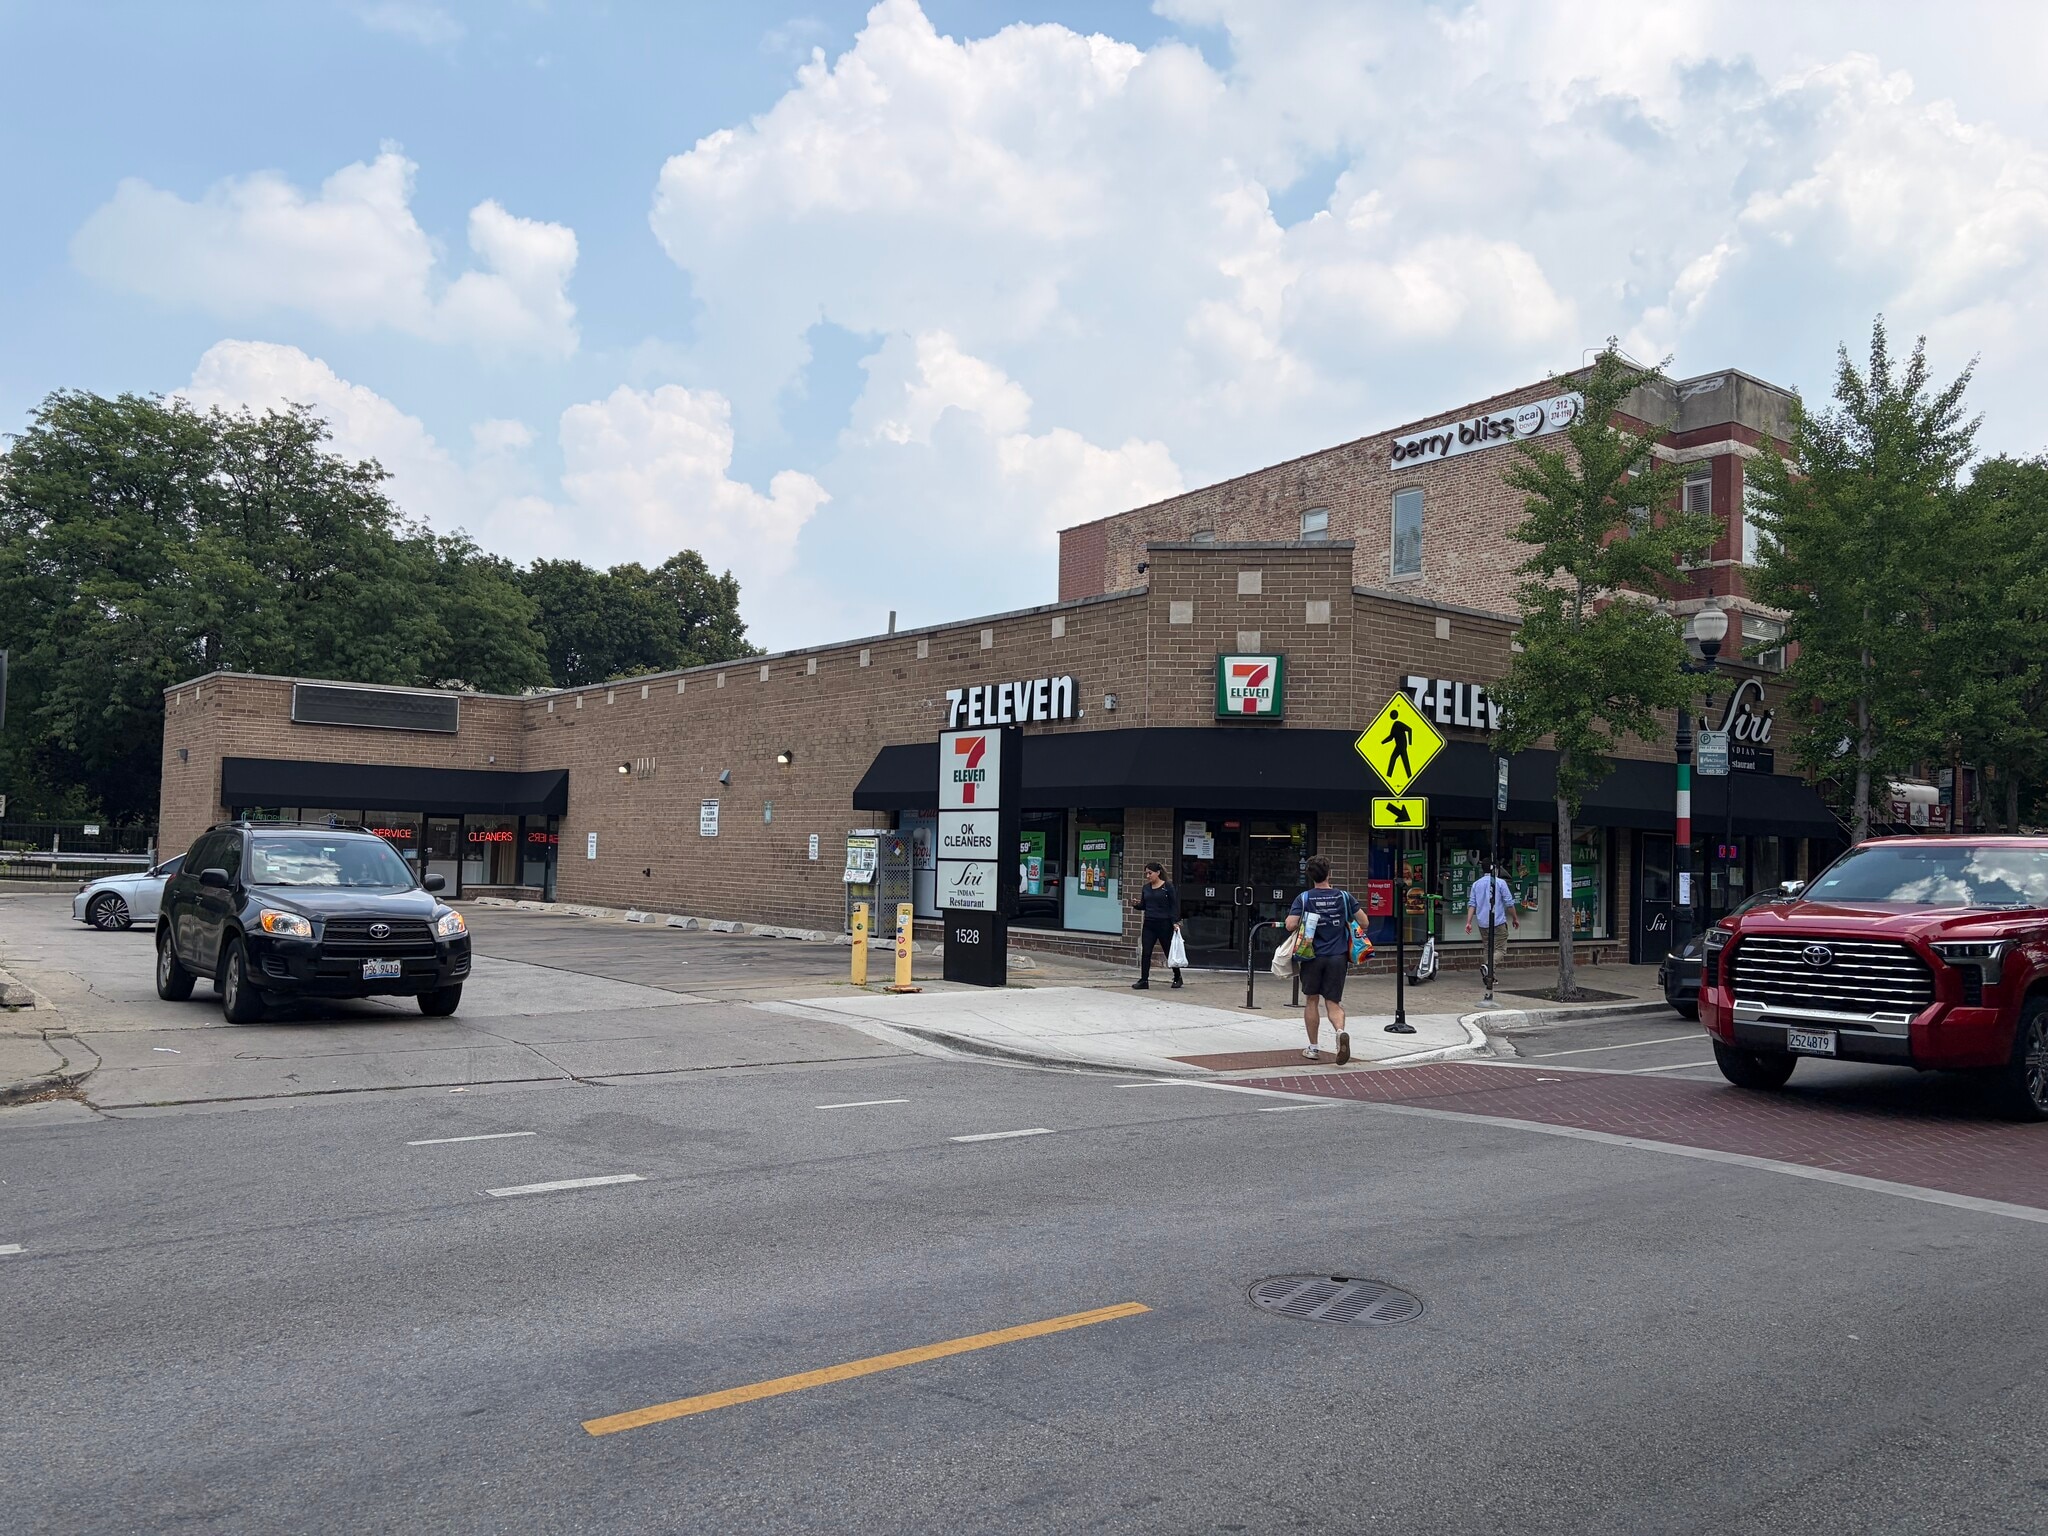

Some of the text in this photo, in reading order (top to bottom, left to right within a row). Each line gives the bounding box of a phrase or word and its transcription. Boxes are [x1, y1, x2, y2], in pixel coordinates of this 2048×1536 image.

[1556, 400, 1568, 410] 312
[1518, 409, 1539, 422] acai
[1391, 416, 1515, 462] berry bliss
[372, 828, 412, 838] SERVICE
[961, 824, 974, 835] OK
[468, 831, 513, 842] CLEANERS
[944, 835, 992, 848] CLEANERS
[1579, 848, 1598, 860] ATM
[1453, 856, 1467, 866] UP
[950, 862, 984, 886] Siri
[957, 889, 976, 897] INDIAN
[949, 897, 985, 908] Restaurant
[955, 928, 980, 945] 1528
